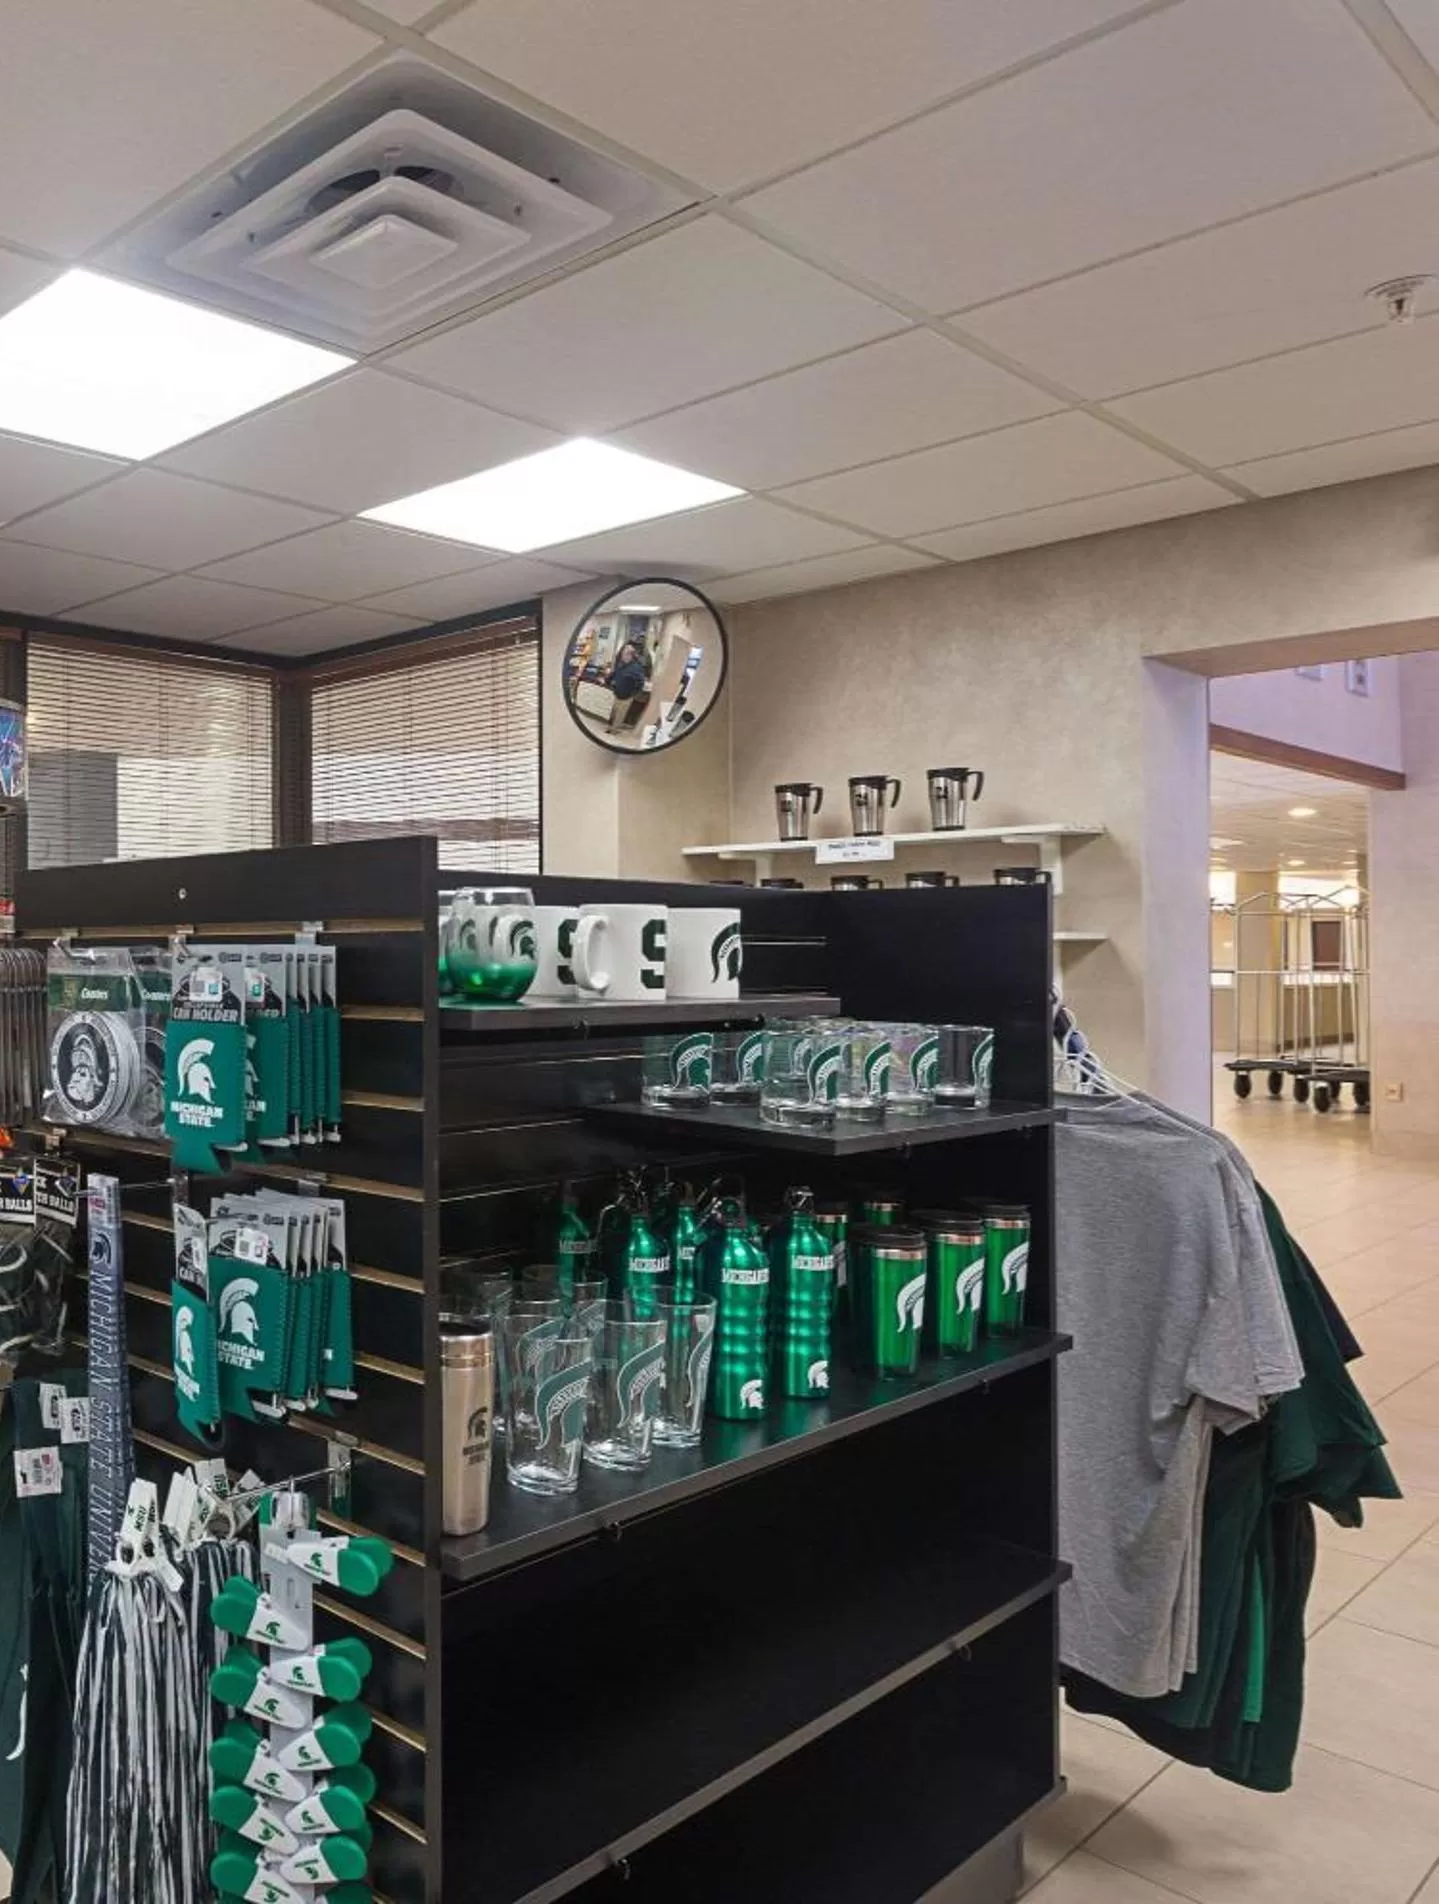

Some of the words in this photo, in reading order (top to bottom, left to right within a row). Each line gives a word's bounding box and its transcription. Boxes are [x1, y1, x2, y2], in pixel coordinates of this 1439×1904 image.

[192, 1008, 238, 1022] HOLDER
[170, 1101, 224, 1119] MICHIGAN
[179, 1113, 212, 1127] STATE
[5, 1198, 33, 1211] BALLS
[89, 1269, 113, 1393] MICHIGAN
[218, 1352, 254, 1370] STATE
[90, 1397, 112, 1479] STATE
[134, 1505, 147, 1532] MSU
